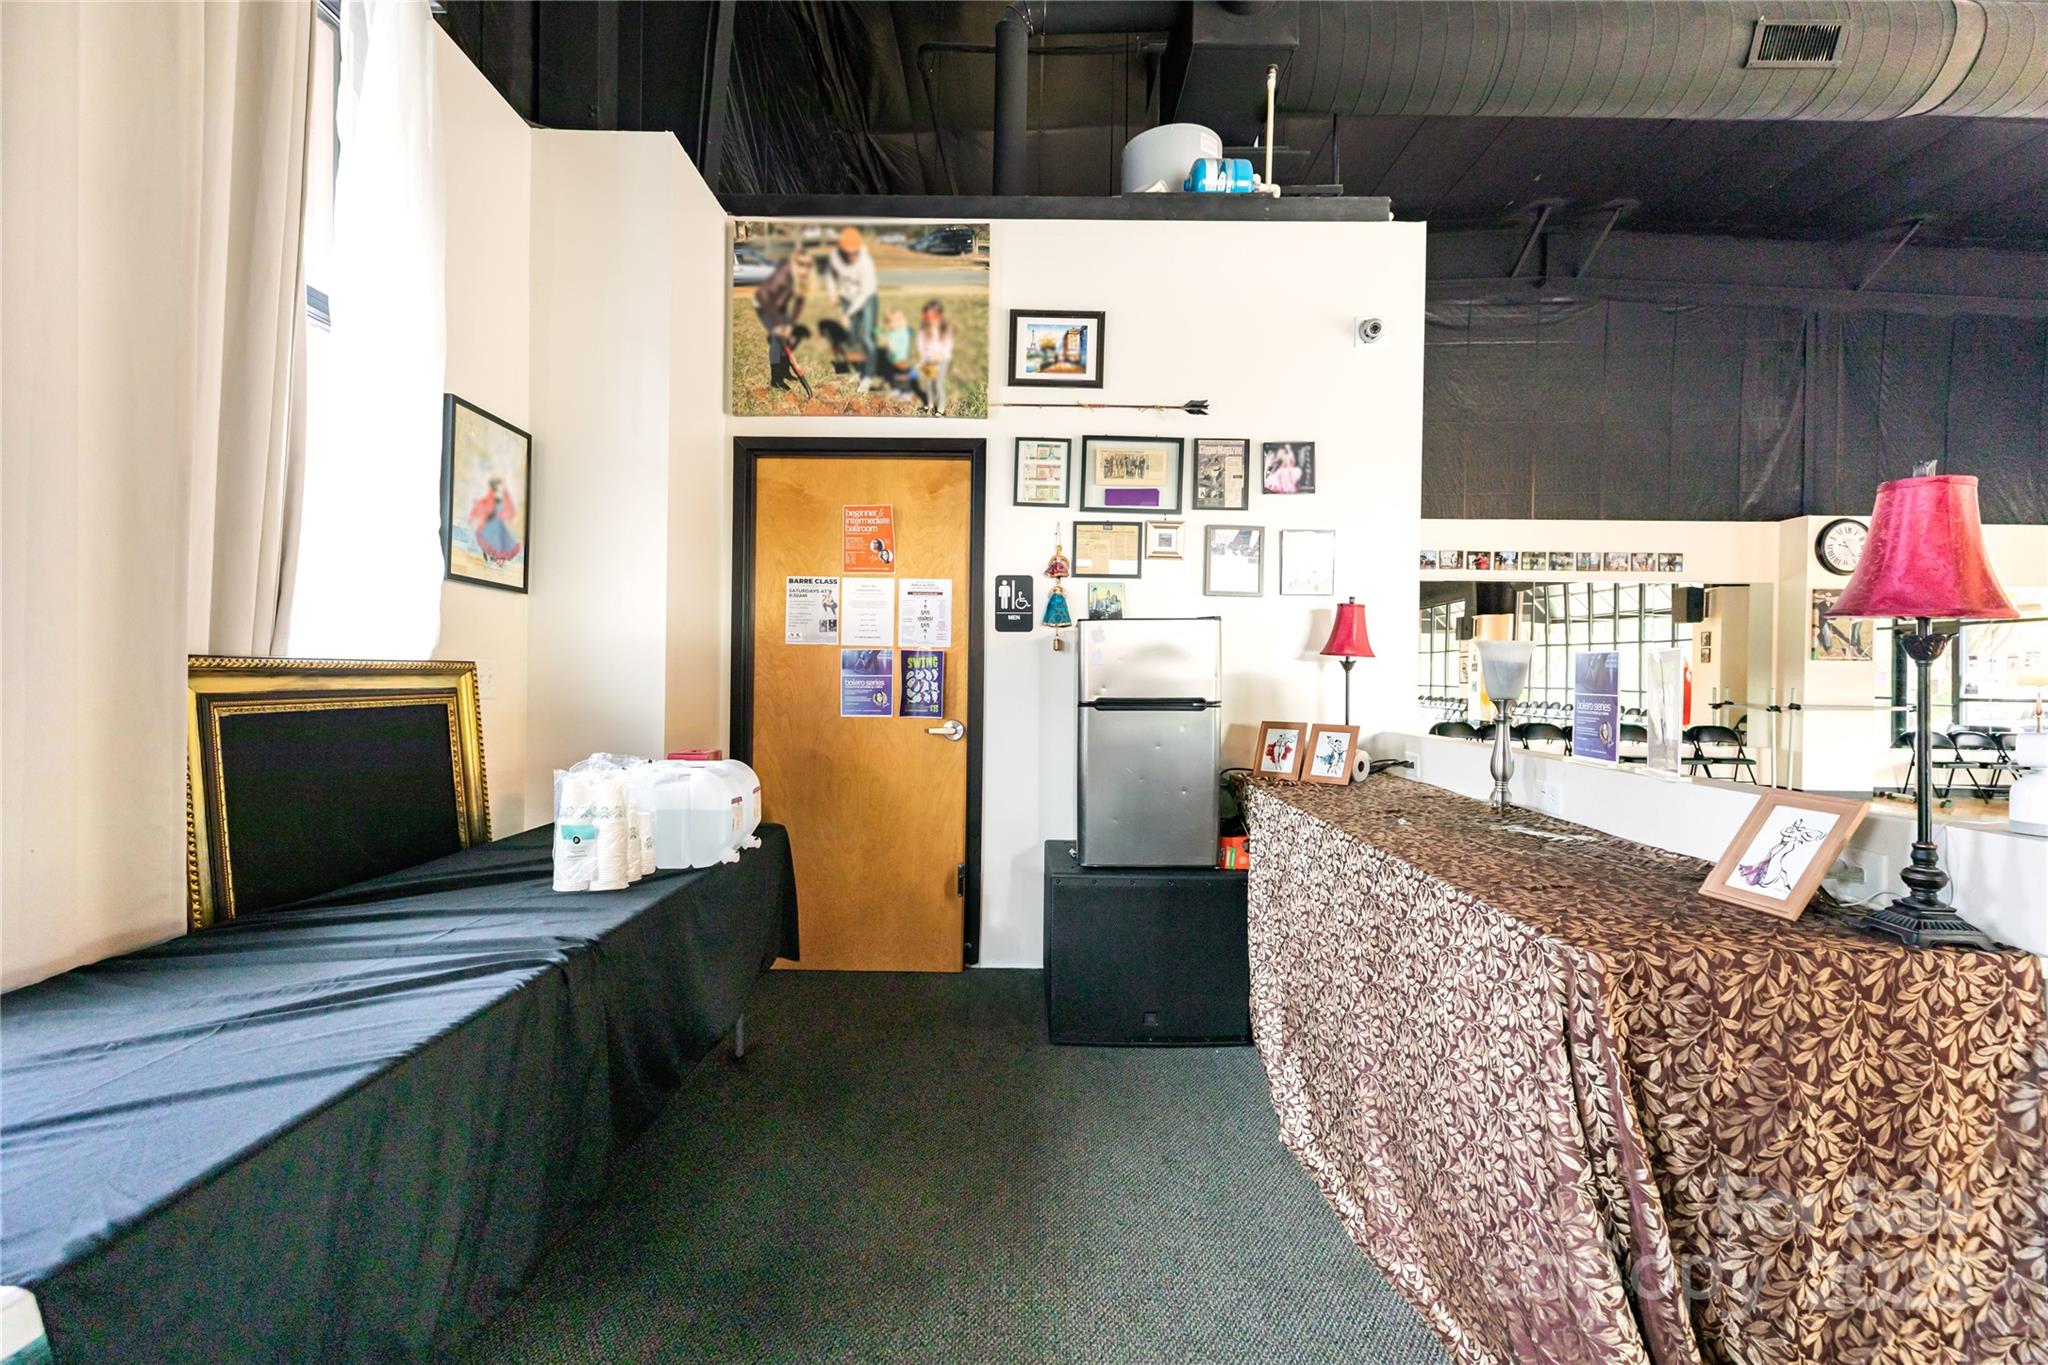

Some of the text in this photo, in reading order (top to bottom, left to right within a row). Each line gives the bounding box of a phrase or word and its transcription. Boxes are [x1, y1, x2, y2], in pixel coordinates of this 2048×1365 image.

[846, 509, 877, 519] beginner
[846, 517, 890, 525] intermediate
[907, 656, 939, 668] SWING
[845, 678, 885, 687] bolero series
[1577, 699, 1612, 712] bolero series
